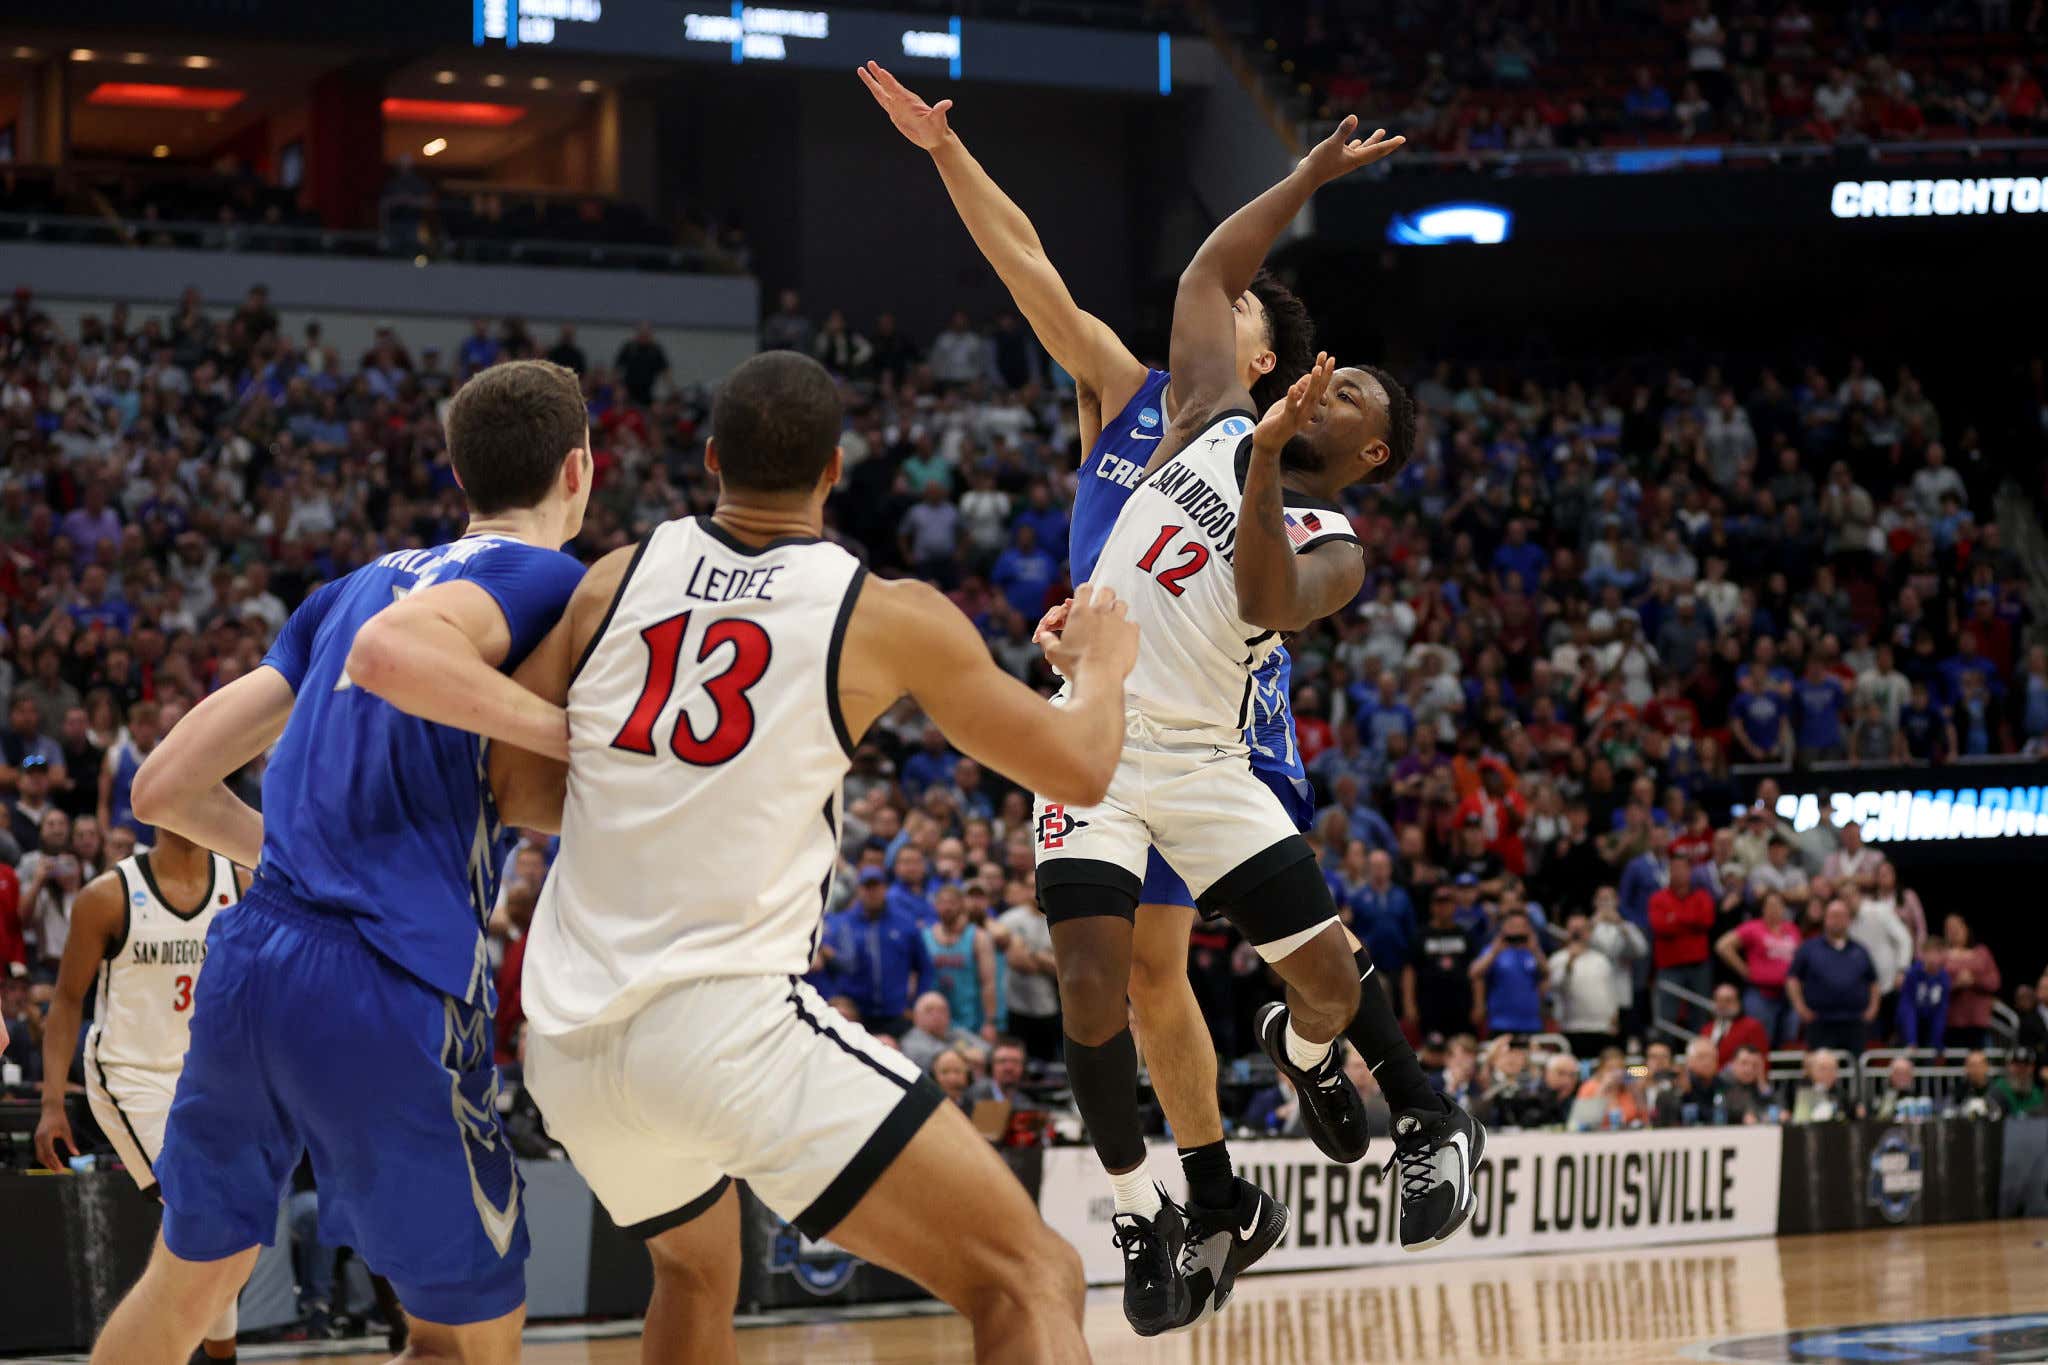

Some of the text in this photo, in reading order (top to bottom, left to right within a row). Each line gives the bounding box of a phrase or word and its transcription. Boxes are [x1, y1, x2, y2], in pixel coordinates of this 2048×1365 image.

[1832, 177, 2048, 218] CREIGHTO
[1148, 461, 1236, 539] SAN DIEGO
[684, 556, 785, 602] LEDEE
[1136, 524, 1210, 598] 12
[609, 608, 773, 767] 13
[133, 941, 158, 964] SAN
[161, 940, 200, 964] DIEGO
[174, 974, 193, 1012] 3
[1469, 1156, 1520, 1238] OF
[1532, 1146, 1738, 1233] LOUISVILLE
